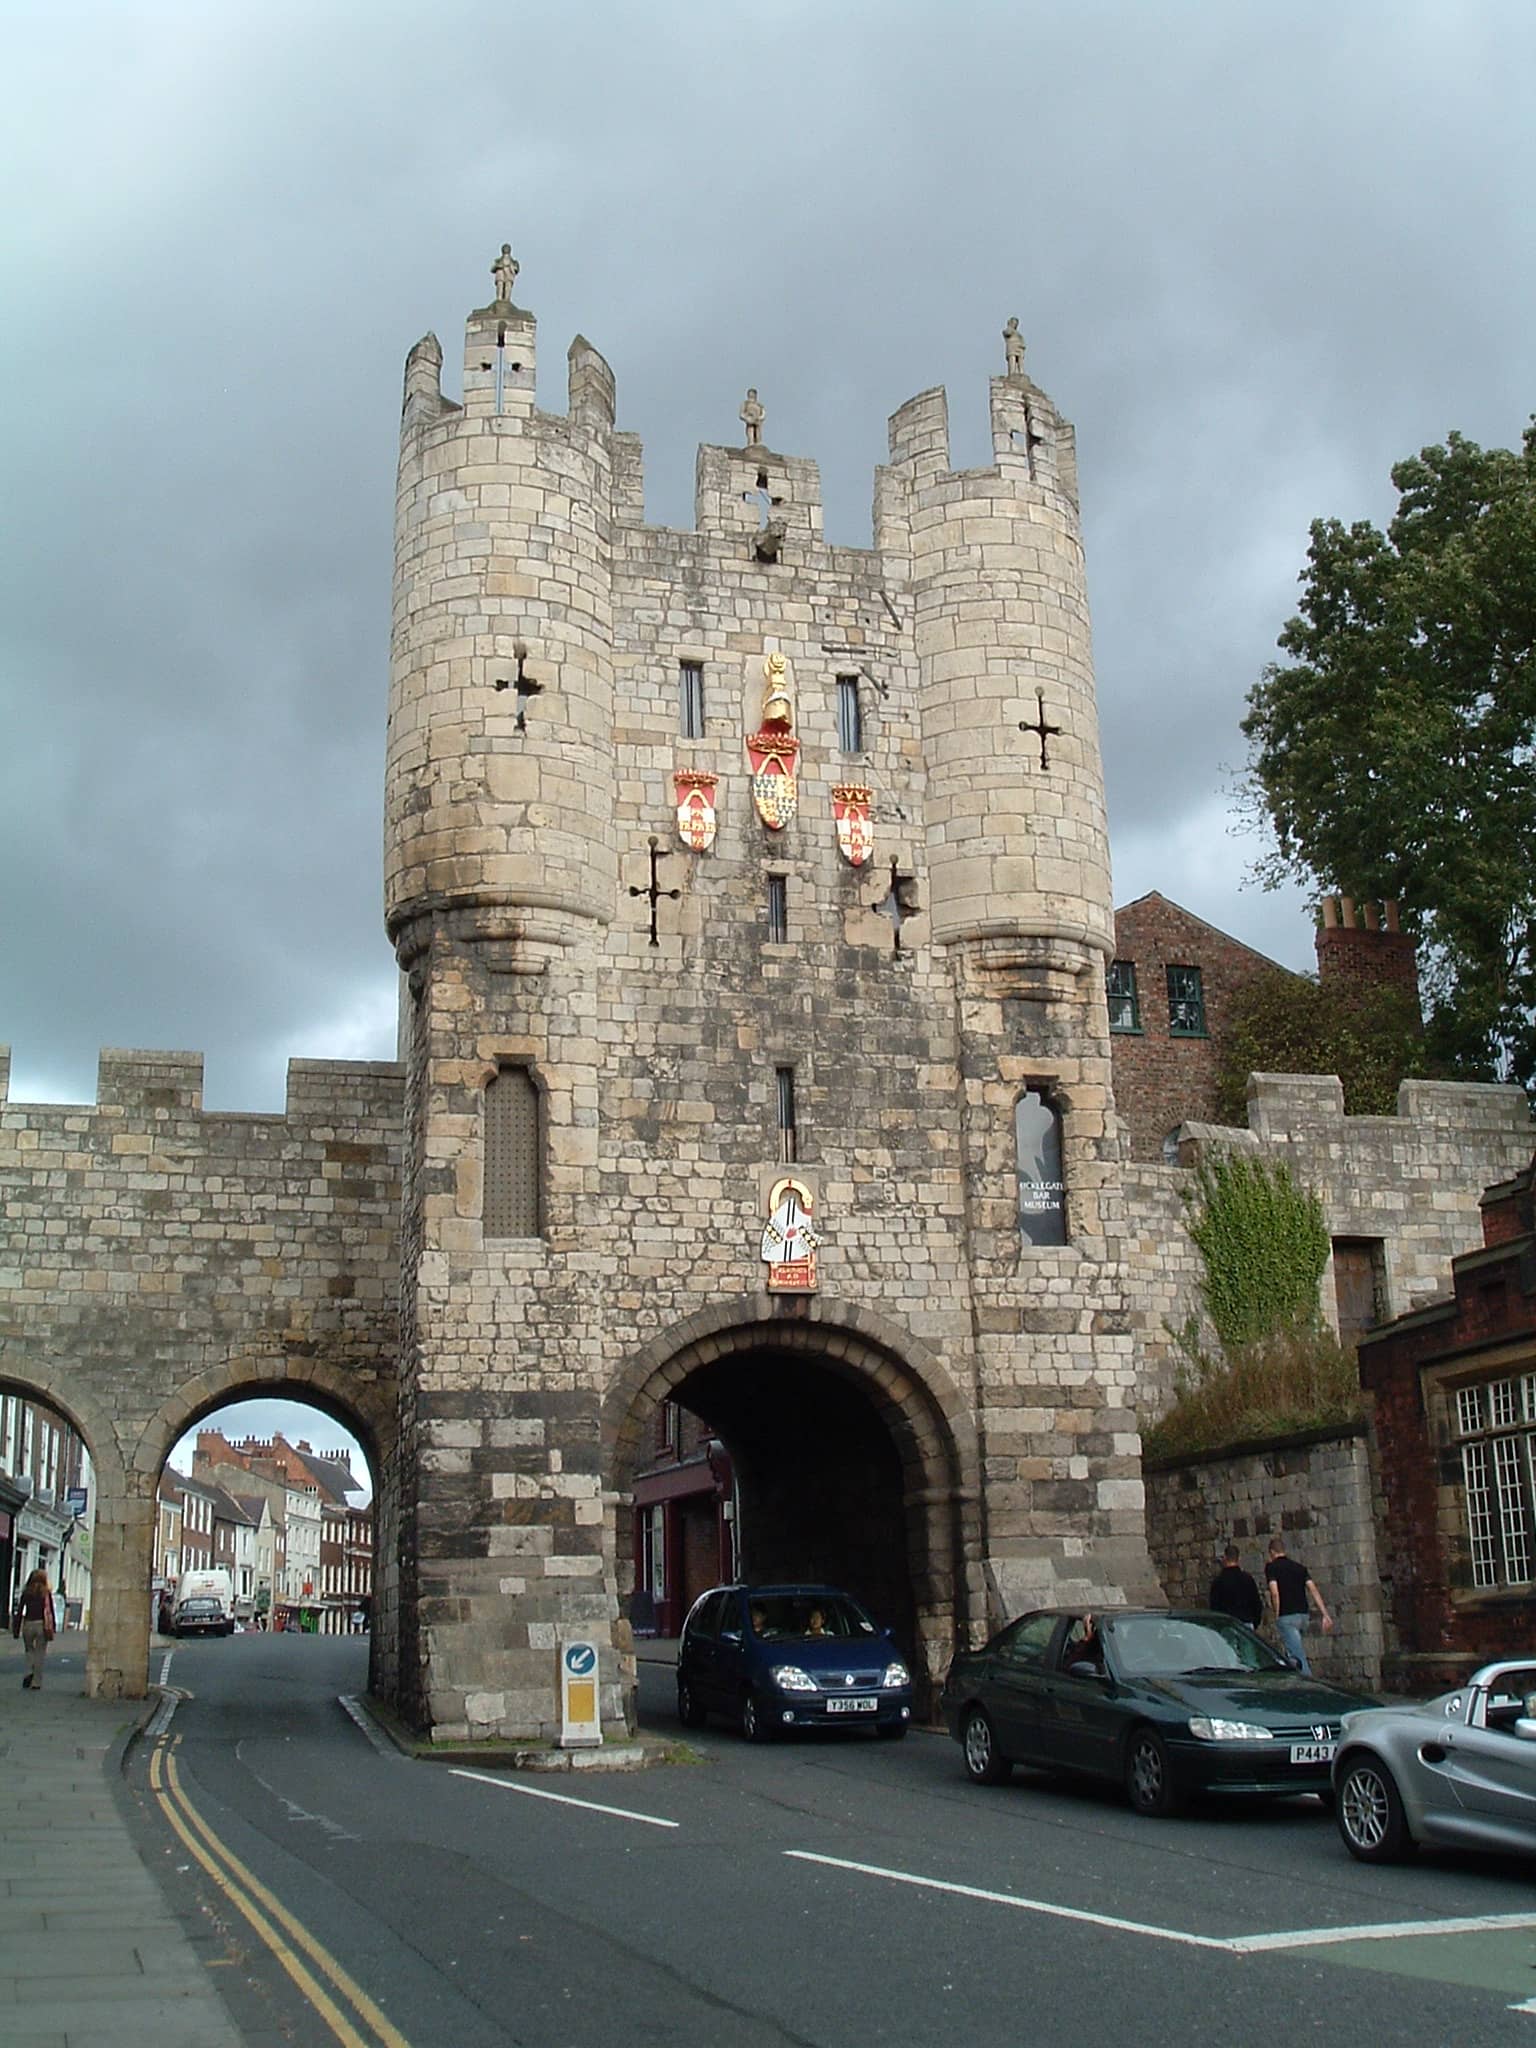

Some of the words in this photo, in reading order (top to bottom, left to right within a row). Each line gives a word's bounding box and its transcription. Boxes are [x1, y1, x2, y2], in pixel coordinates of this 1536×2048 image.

[1033, 1191, 1050, 1200] BAR
[1024, 1201, 1060, 1209] MUSEUM
[1297, 1746, 1329, 1760] P443
